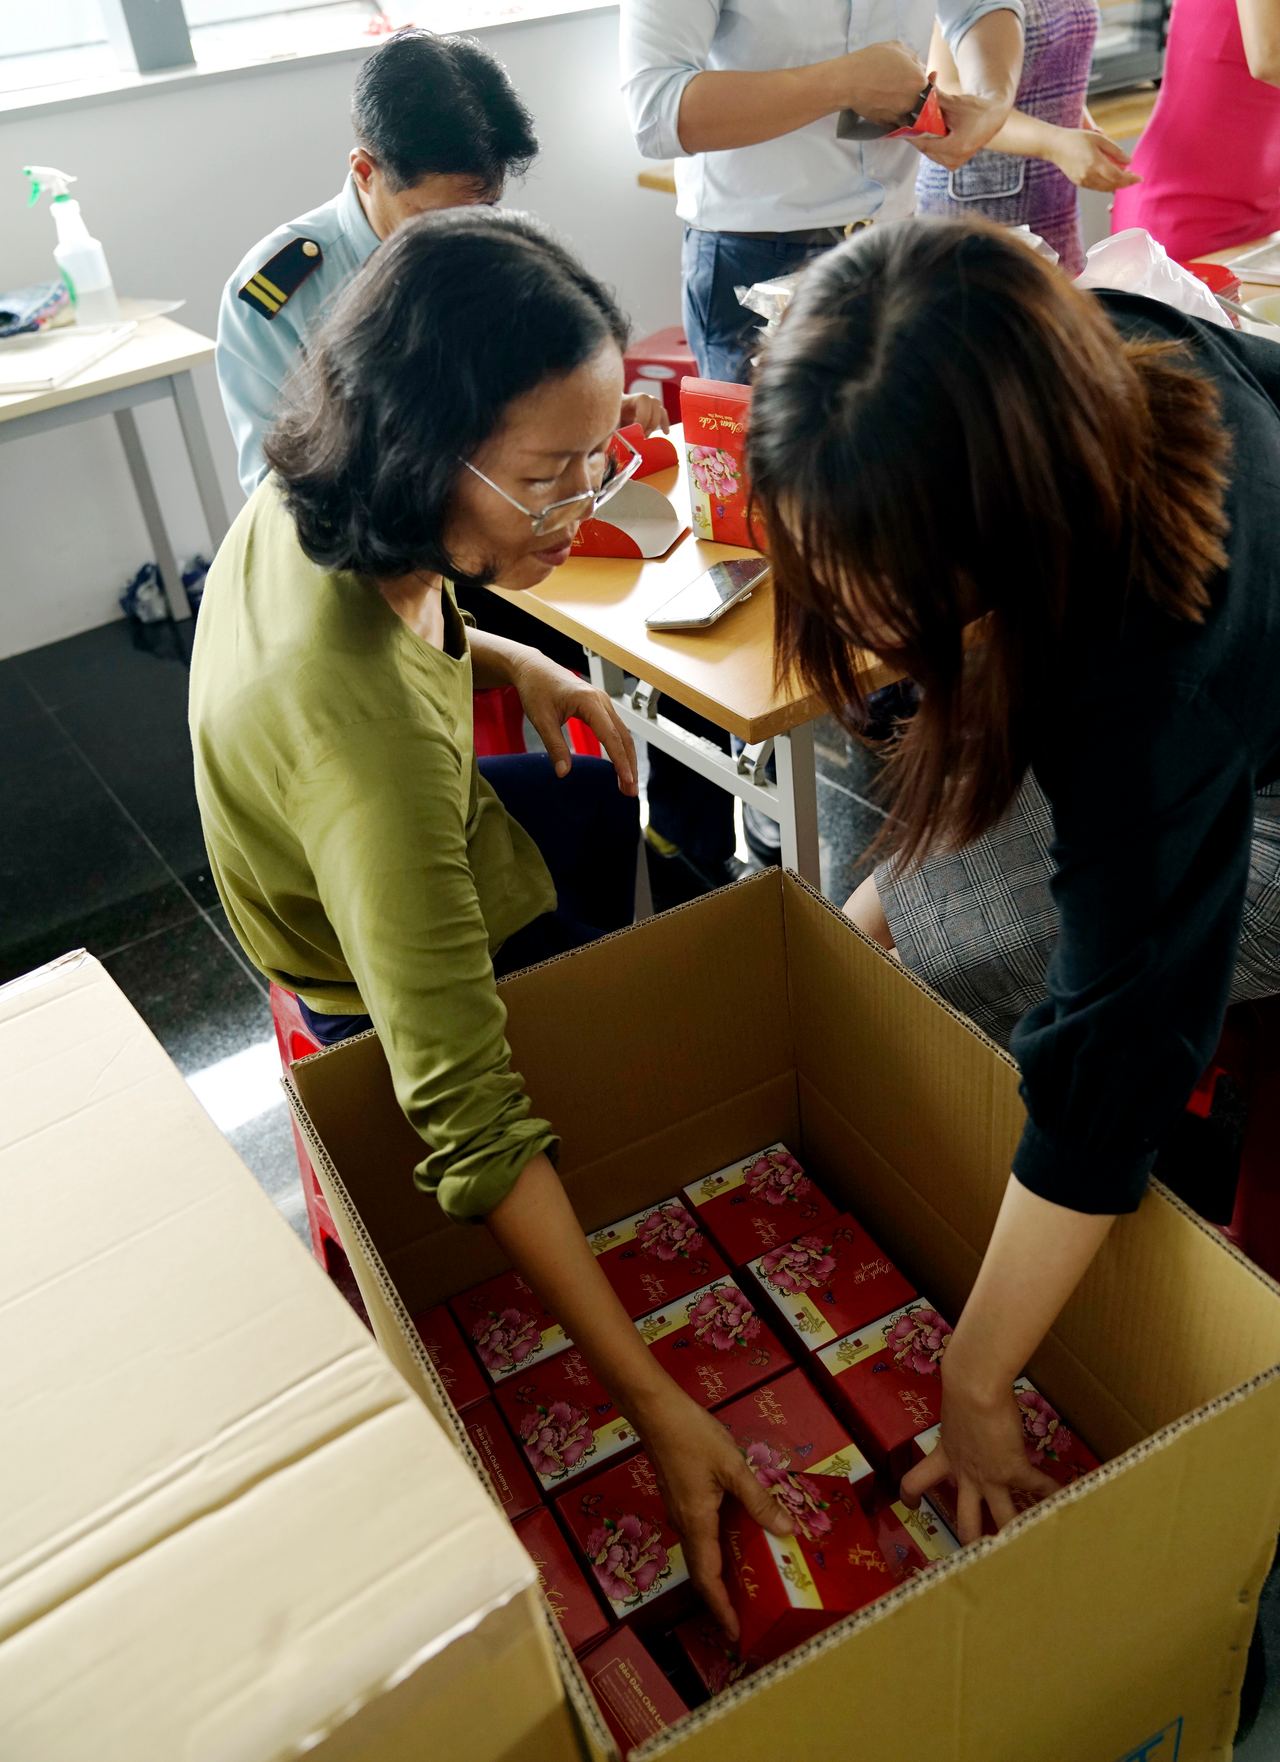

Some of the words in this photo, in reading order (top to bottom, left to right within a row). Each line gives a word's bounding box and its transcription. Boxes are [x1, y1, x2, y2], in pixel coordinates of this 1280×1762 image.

[698, 416, 718, 430] Cake
[437, 1364, 457, 1389] Cake
[740, 1564, 759, 1598] Cake
[544, 1585, 568, 1620] Cake
